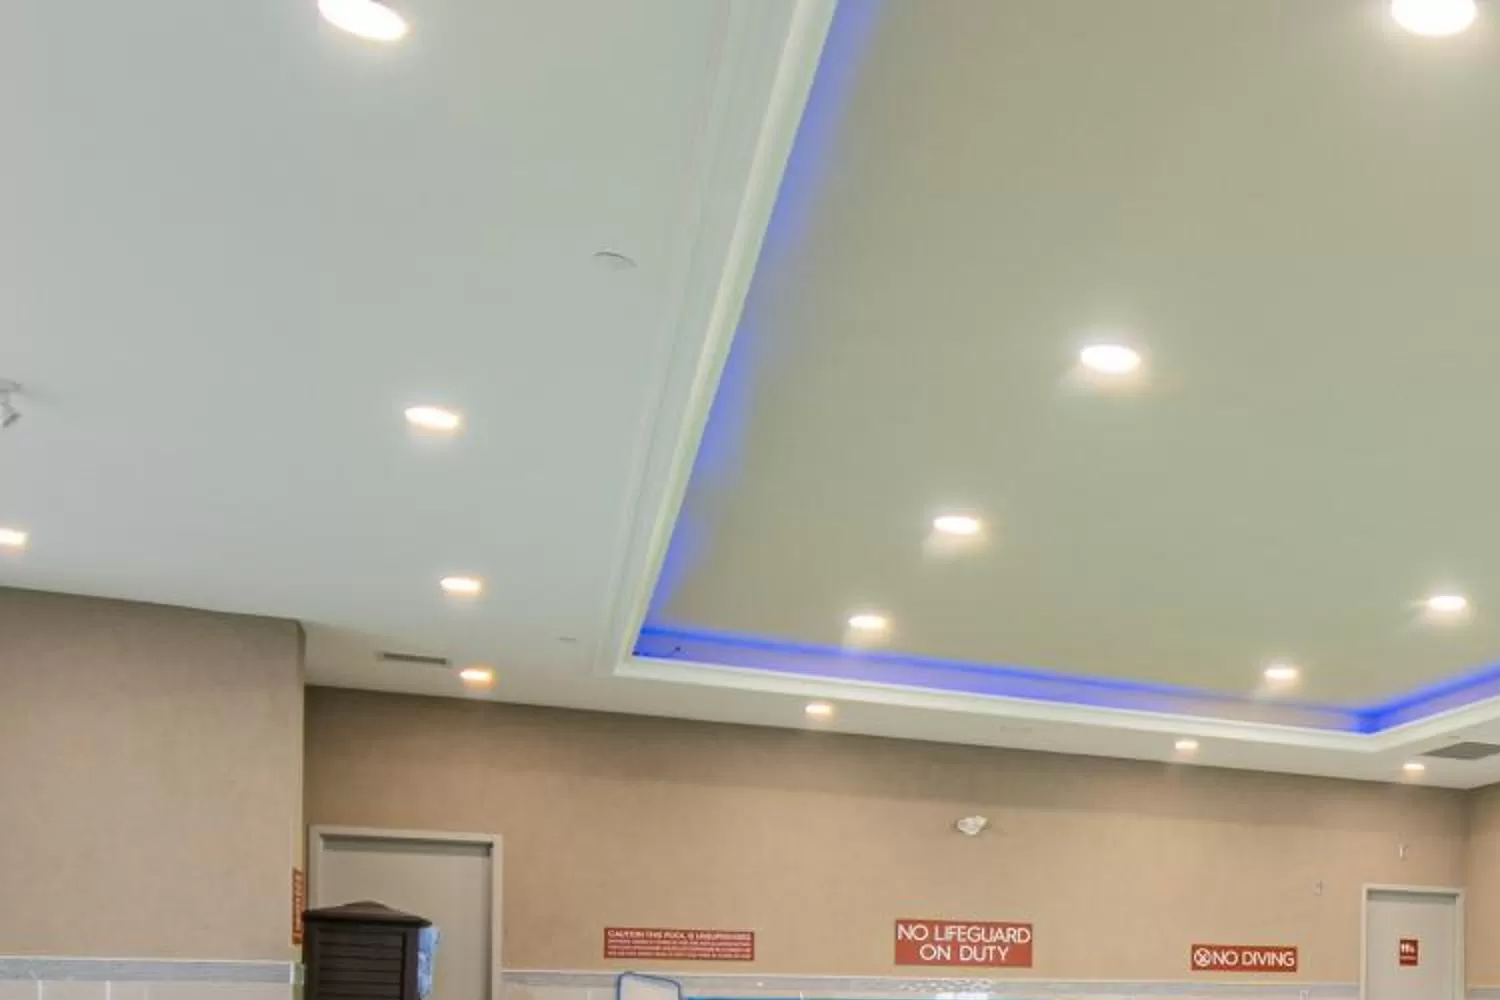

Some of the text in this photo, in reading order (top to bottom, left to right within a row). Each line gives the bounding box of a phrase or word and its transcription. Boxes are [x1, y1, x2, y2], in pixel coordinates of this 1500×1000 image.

[897, 923, 1031, 944] NO LIFEGUARD
[919, 943, 1009, 962] ON DUTY
[1212, 949, 1296, 967] NO DIVING
